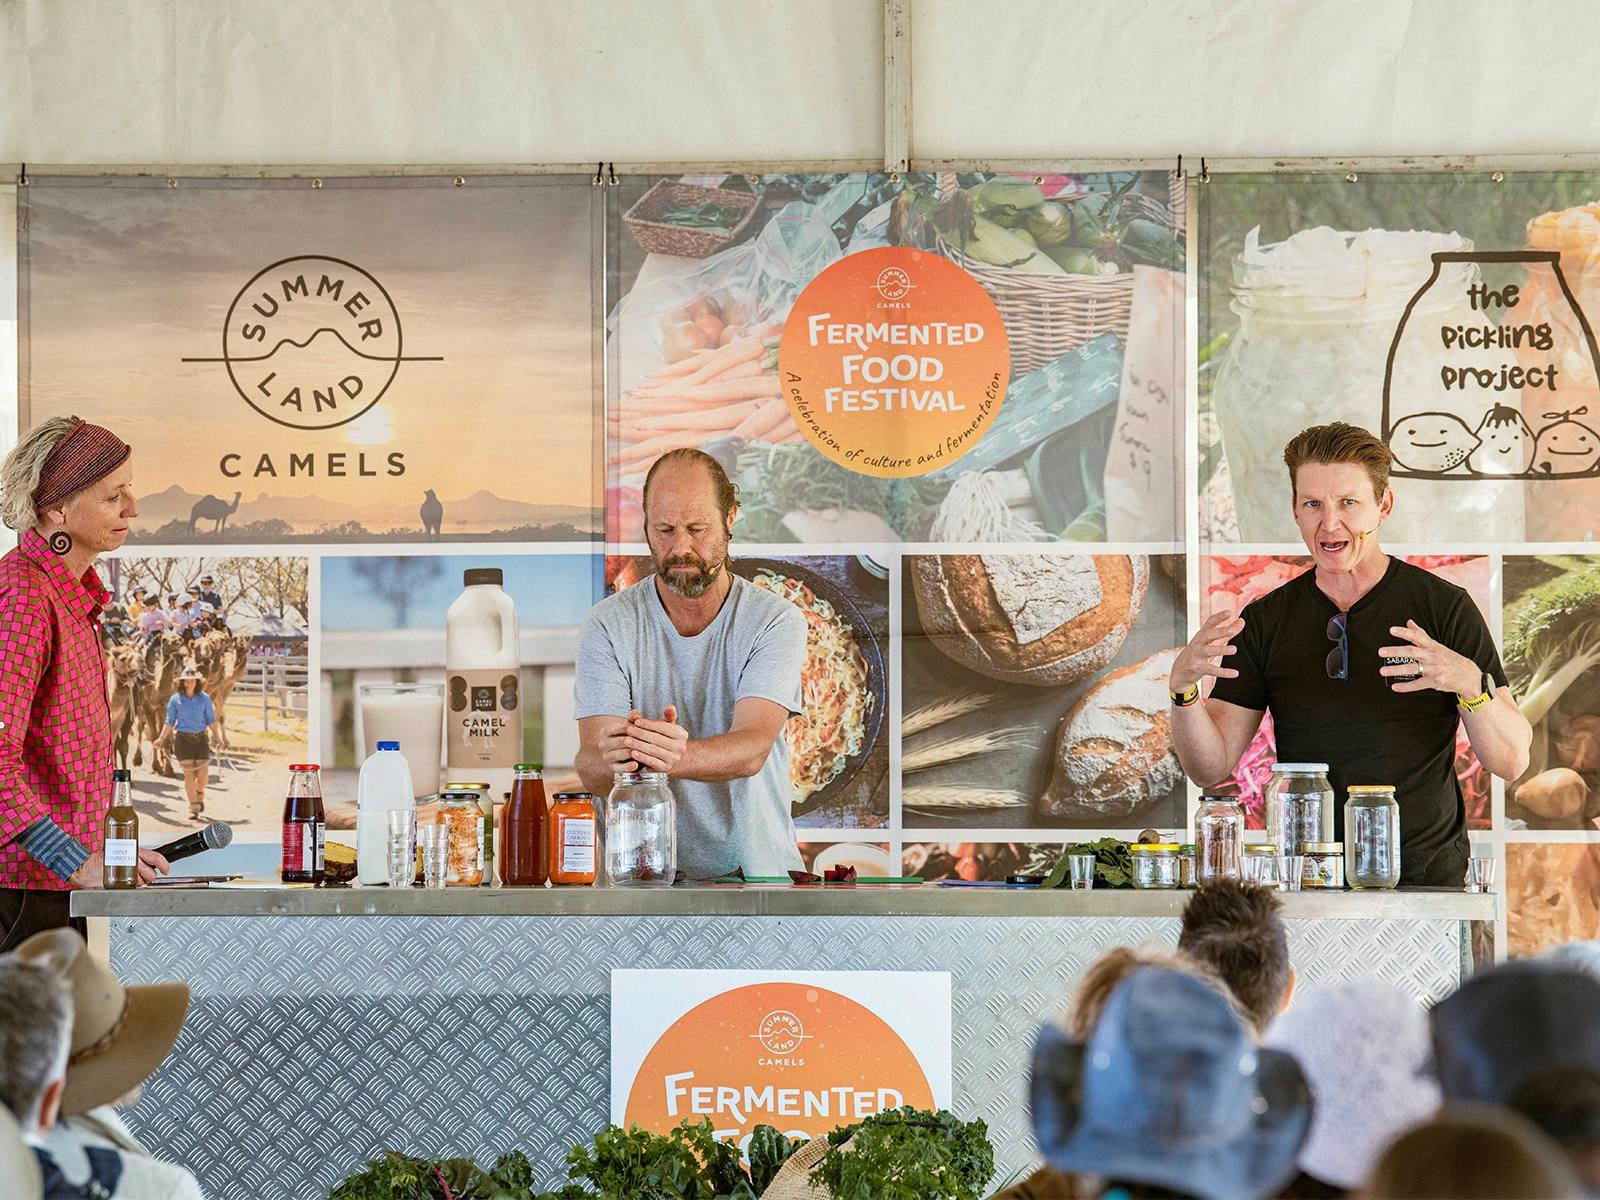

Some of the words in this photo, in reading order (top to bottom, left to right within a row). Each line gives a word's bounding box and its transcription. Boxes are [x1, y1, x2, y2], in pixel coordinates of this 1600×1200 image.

[884, 288, 904, 297] LAND
[1466, 283, 1520, 310] the
[242, 274, 384, 342] SUMMER
[808, 313, 984, 351] FERMENTED
[786, 371, 801, 383] A
[842, 354, 944, 385] FOOD
[1441, 364, 1559, 391] project
[257, 371, 364, 412] LAND
[824, 387, 965, 413] FESTIVAL
[791, 386, 840, 452] celebration
[946, 372, 1001, 453] fermentation
[219, 452, 406, 477] CAMELS
[845, 449, 864, 464] of
[863, 455, 912, 468] culture
[917, 444, 943, 465] and
[1386, 656, 1416, 664] SABARA
[462, 718, 506, 727] CAMEL
[469, 728, 500, 737] MILK
[763, 1015, 799, 1032] SUMMER
[767, 1039, 795, 1050] LAND
[758, 1058, 805, 1066] CAMELS
[664, 1071, 904, 1125] FERMENTED
